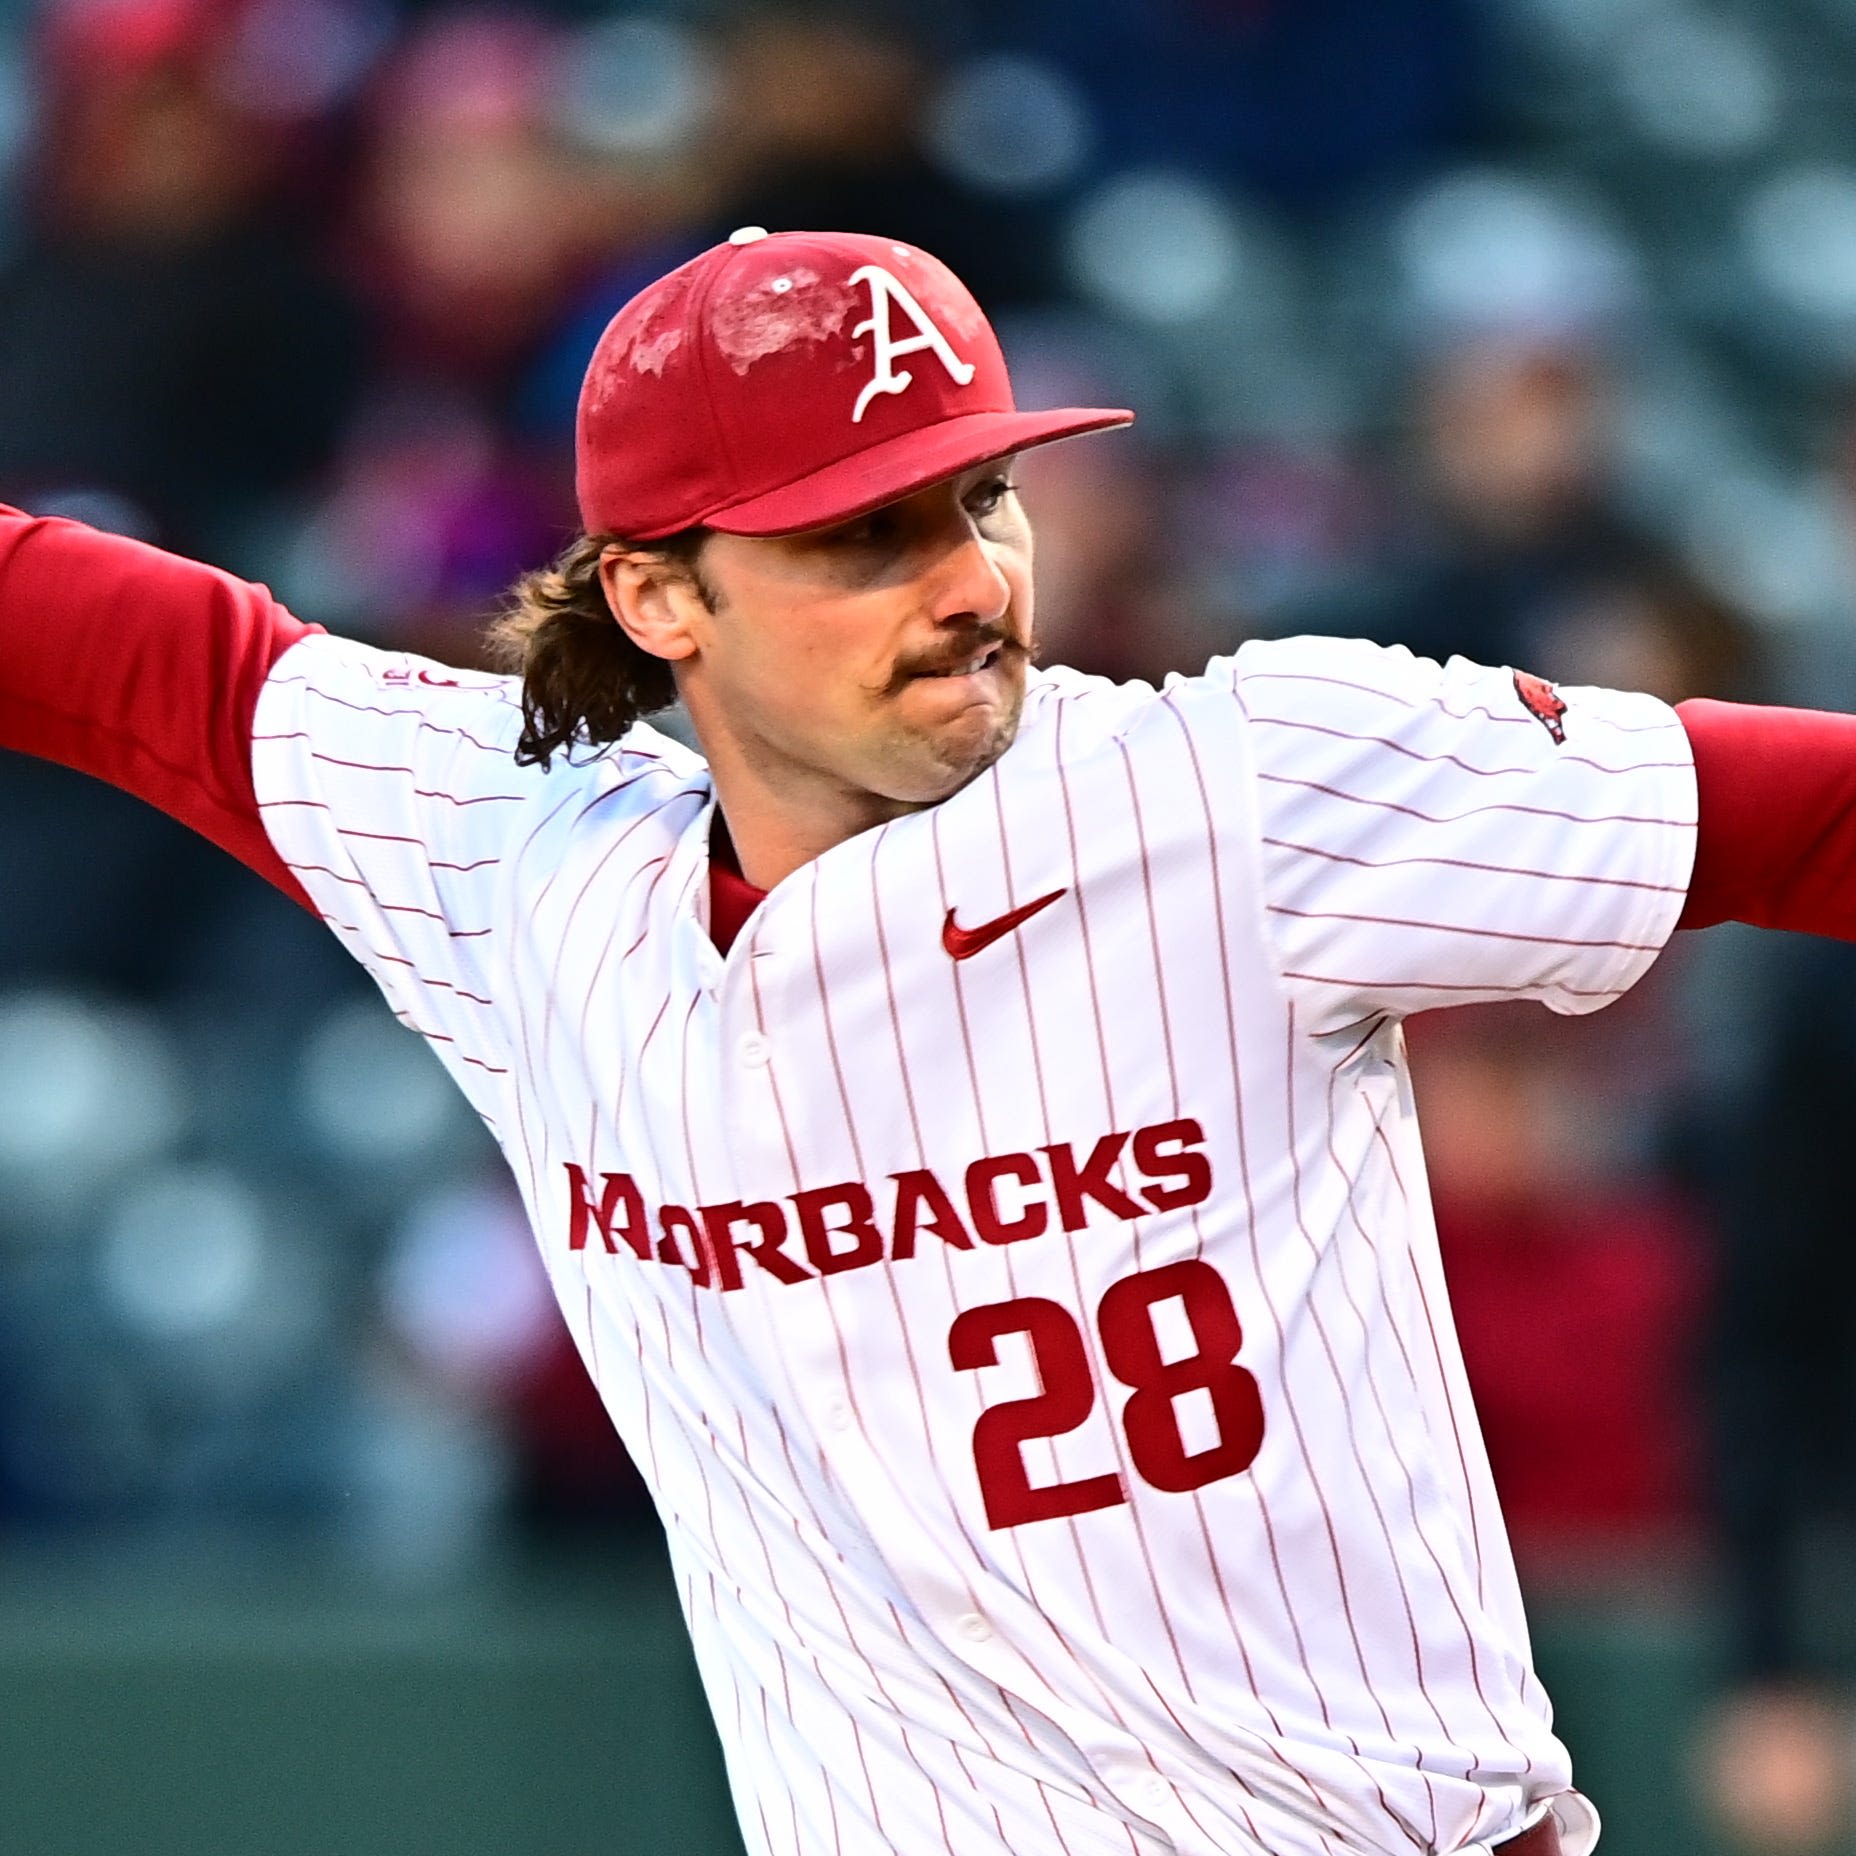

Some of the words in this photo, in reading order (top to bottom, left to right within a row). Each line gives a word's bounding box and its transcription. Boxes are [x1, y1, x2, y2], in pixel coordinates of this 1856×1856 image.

[847, 264, 976, 423] A
[562, 1117, 1212, 1292] RAORBACKS
[946, 1258, 1266, 1532] 28
